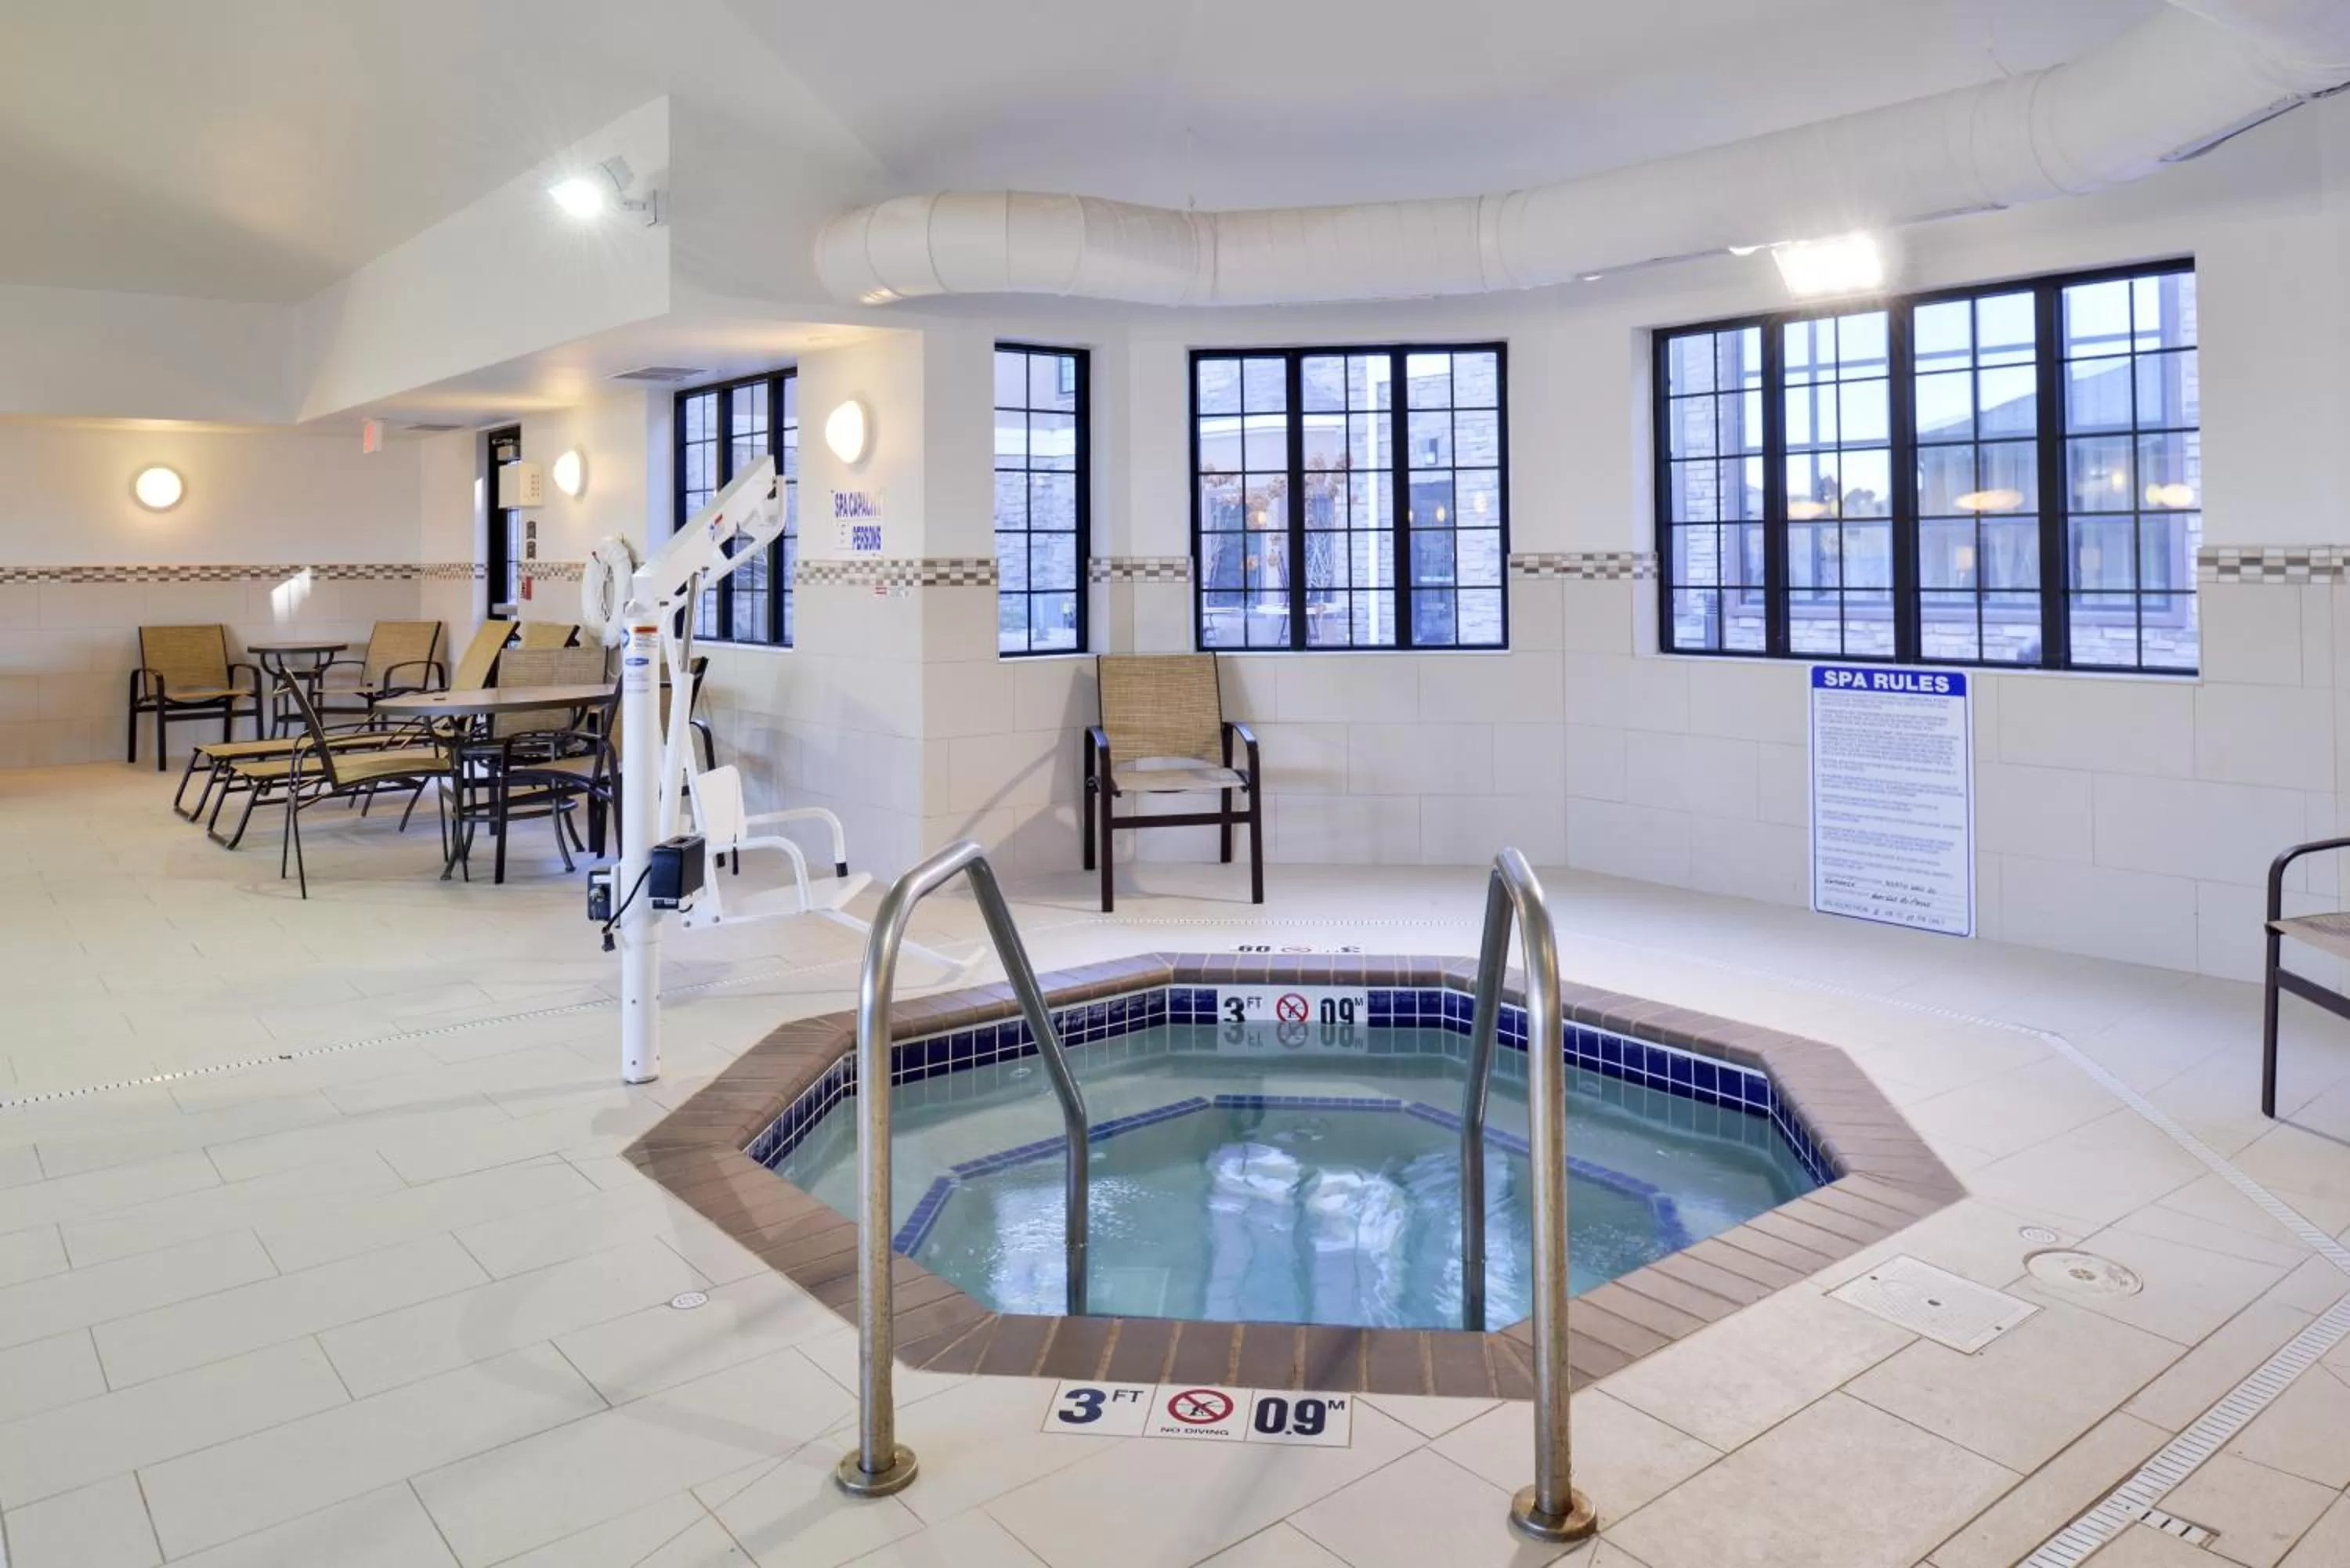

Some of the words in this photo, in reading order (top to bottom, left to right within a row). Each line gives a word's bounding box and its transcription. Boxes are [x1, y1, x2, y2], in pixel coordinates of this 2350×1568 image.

[835, 492, 848, 518] SPA
[1824, 670, 1867, 688] SPA
[1873, 673, 1950, 693] RULES
[1223, 996, 1245, 1023] 3
[1247, 996, 1263, 1009] FT
[1354, 997, 1364, 1006] M
[1058, 1388, 1107, 1425] 3
[1112, 1389, 1144, 1404] FT
[1254, 1396, 1326, 1436] 0.9
[1328, 1400, 1346, 1411] M
[1184, 1428, 1230, 1436] DIVING
